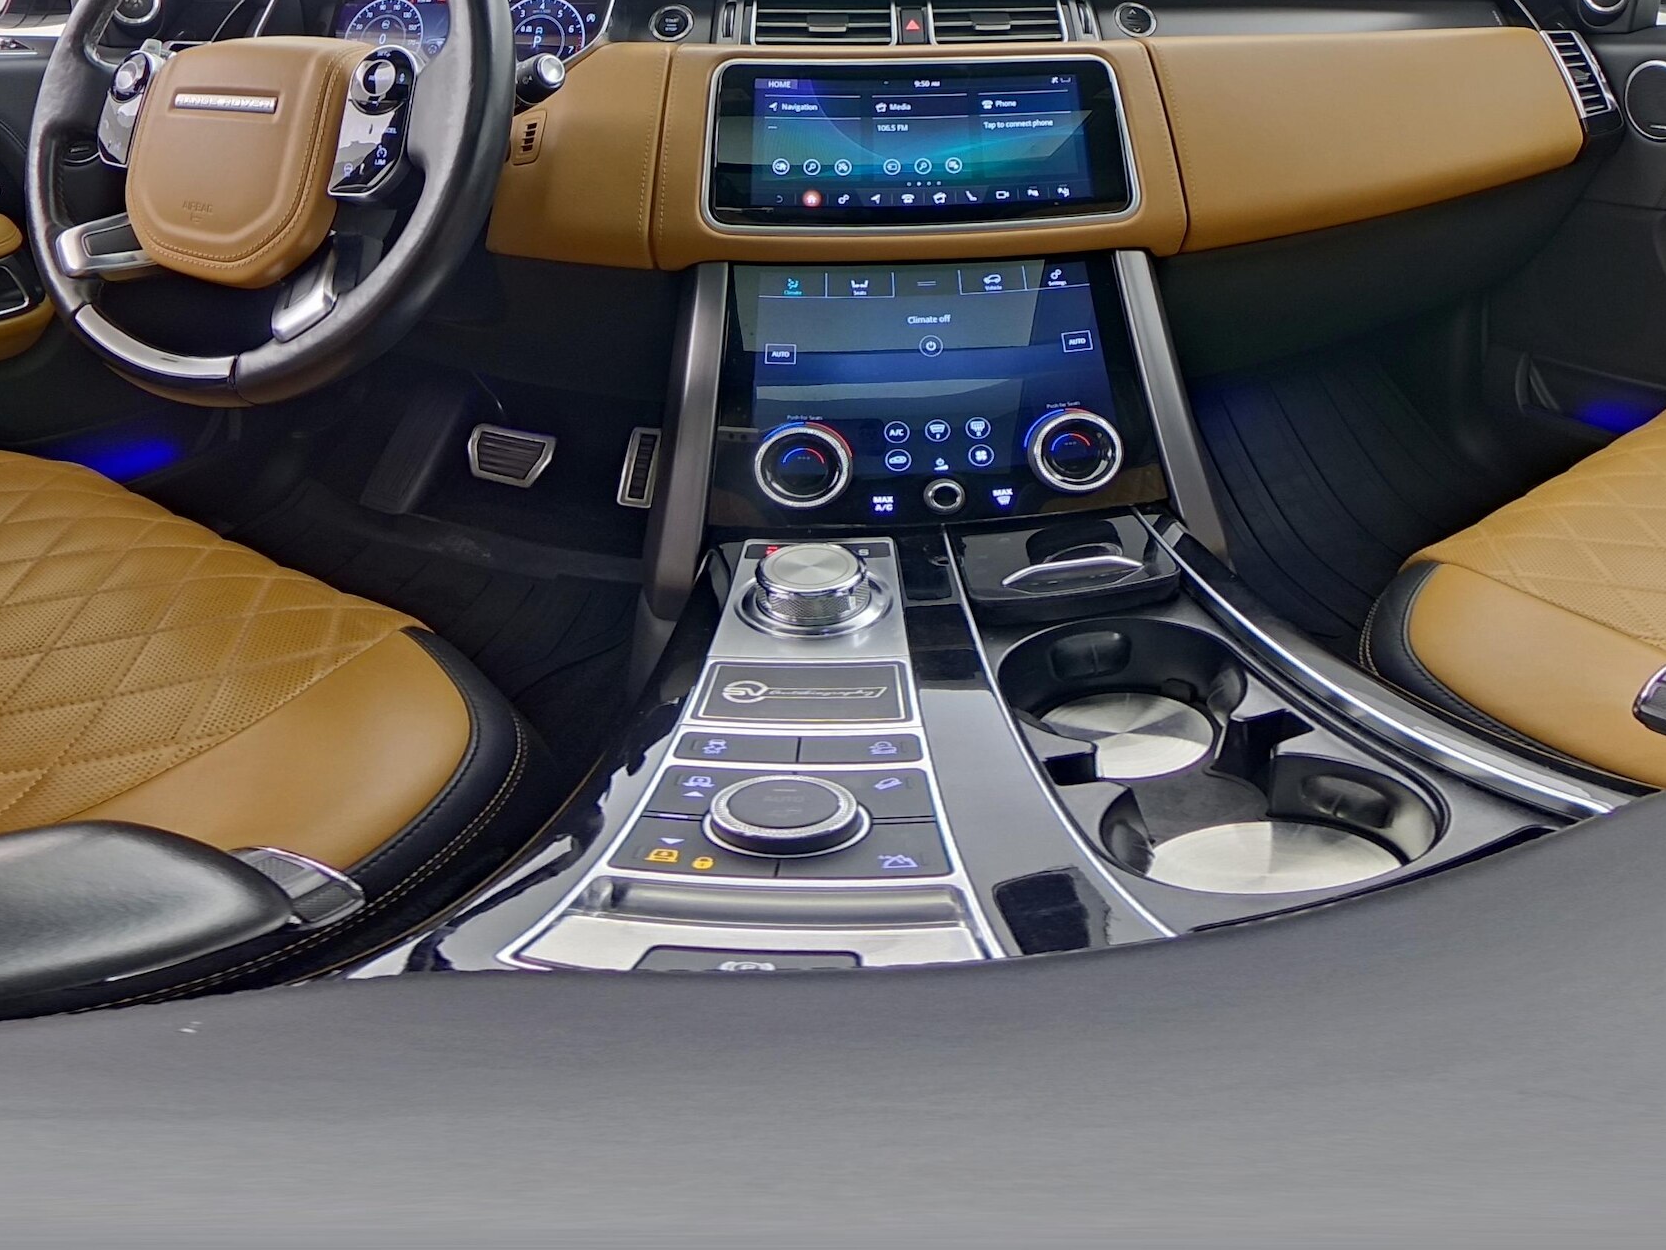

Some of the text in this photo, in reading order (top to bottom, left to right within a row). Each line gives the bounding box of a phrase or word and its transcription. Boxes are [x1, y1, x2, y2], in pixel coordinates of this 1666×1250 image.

[378, 33, 386, 44] 0
[533, 36, 541, 48] P
[767, 80, 791, 88] HOME
[914, 80, 930, 88] 9:50
[177, 97, 271, 109] RANGE ROVER
[889, 103, 911, 111] Media
[995, 100, 1017, 108] Phone
[781, 103, 818, 112] Navigation
[897, 124, 908, 132] FM
[983, 119, 1053, 130] Tap to connect phone
[907, 314, 951, 324] Climate off
[889, 429, 904, 437] A/C
[992, 488, 1013, 496] MAX
[858, 548, 869, 556] S
